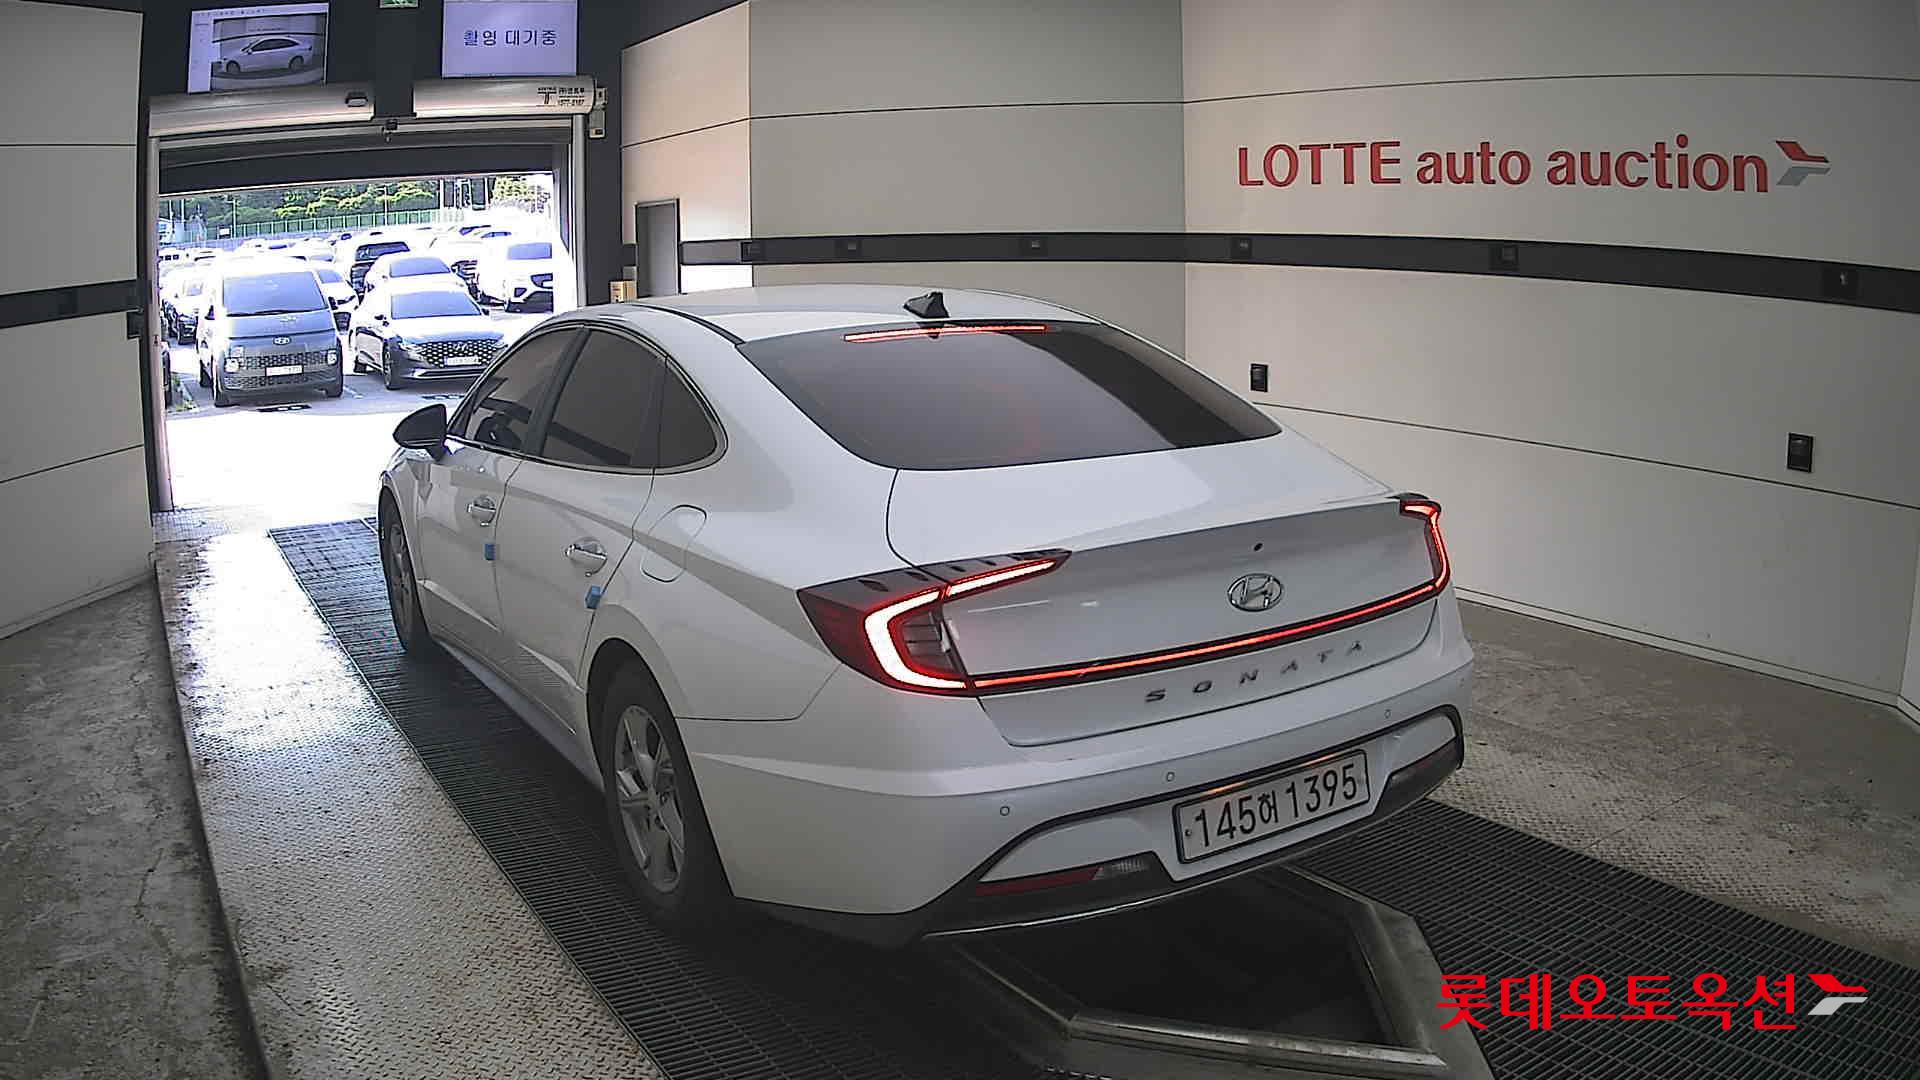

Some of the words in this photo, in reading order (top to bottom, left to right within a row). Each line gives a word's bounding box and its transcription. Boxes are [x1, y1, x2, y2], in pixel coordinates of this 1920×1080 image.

[505, 29, 557, 46] 대기중
[1238, 140, 1401, 187] LOTTE
[1416, 141, 1531, 186] auto
[1547, 133, 1769, 193] auction
[1144, 640, 1364, 702] SONATA
